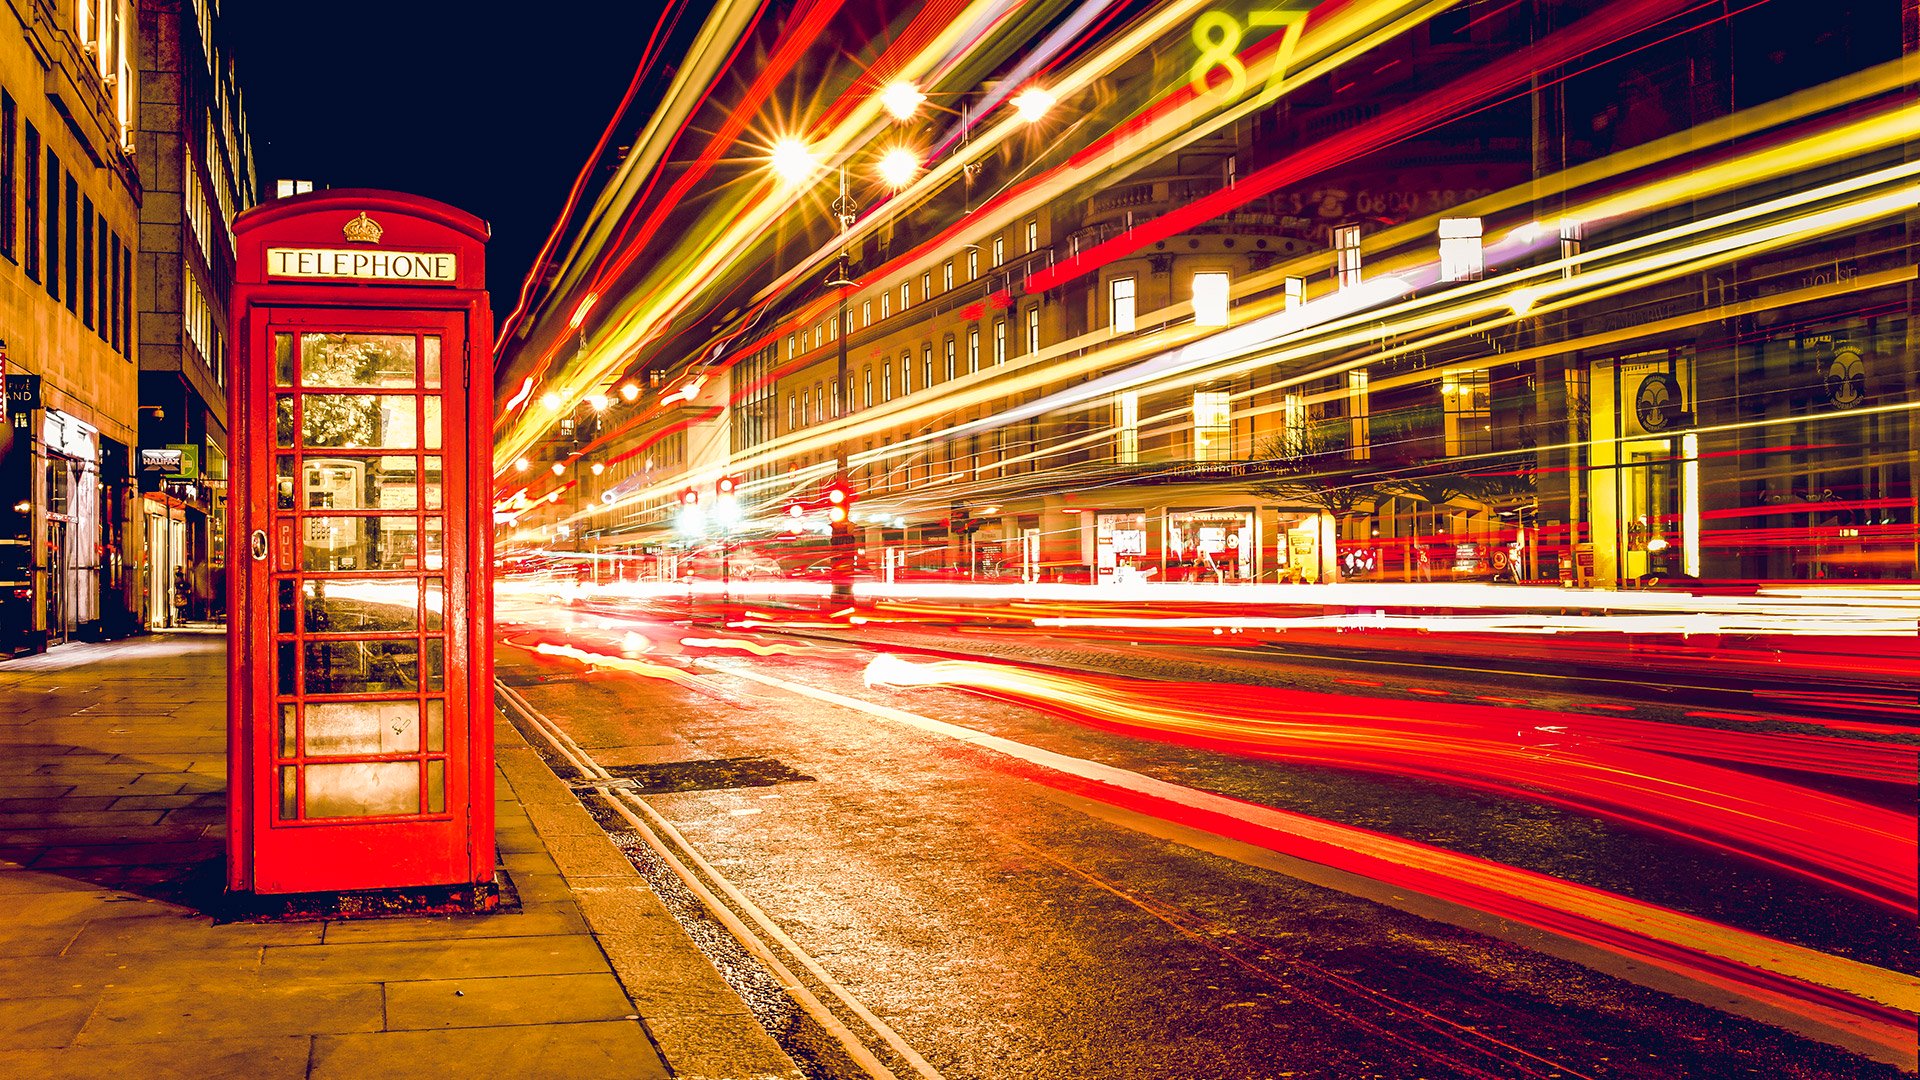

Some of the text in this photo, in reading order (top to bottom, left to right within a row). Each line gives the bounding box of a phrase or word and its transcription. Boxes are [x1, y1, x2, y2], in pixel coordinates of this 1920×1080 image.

[1191, 11, 1309, 104] 87
[275, 251, 449, 279] TELEPHONE
[142, 457, 180, 466] HALIFAX
[282, 525, 290, 566] PULL
